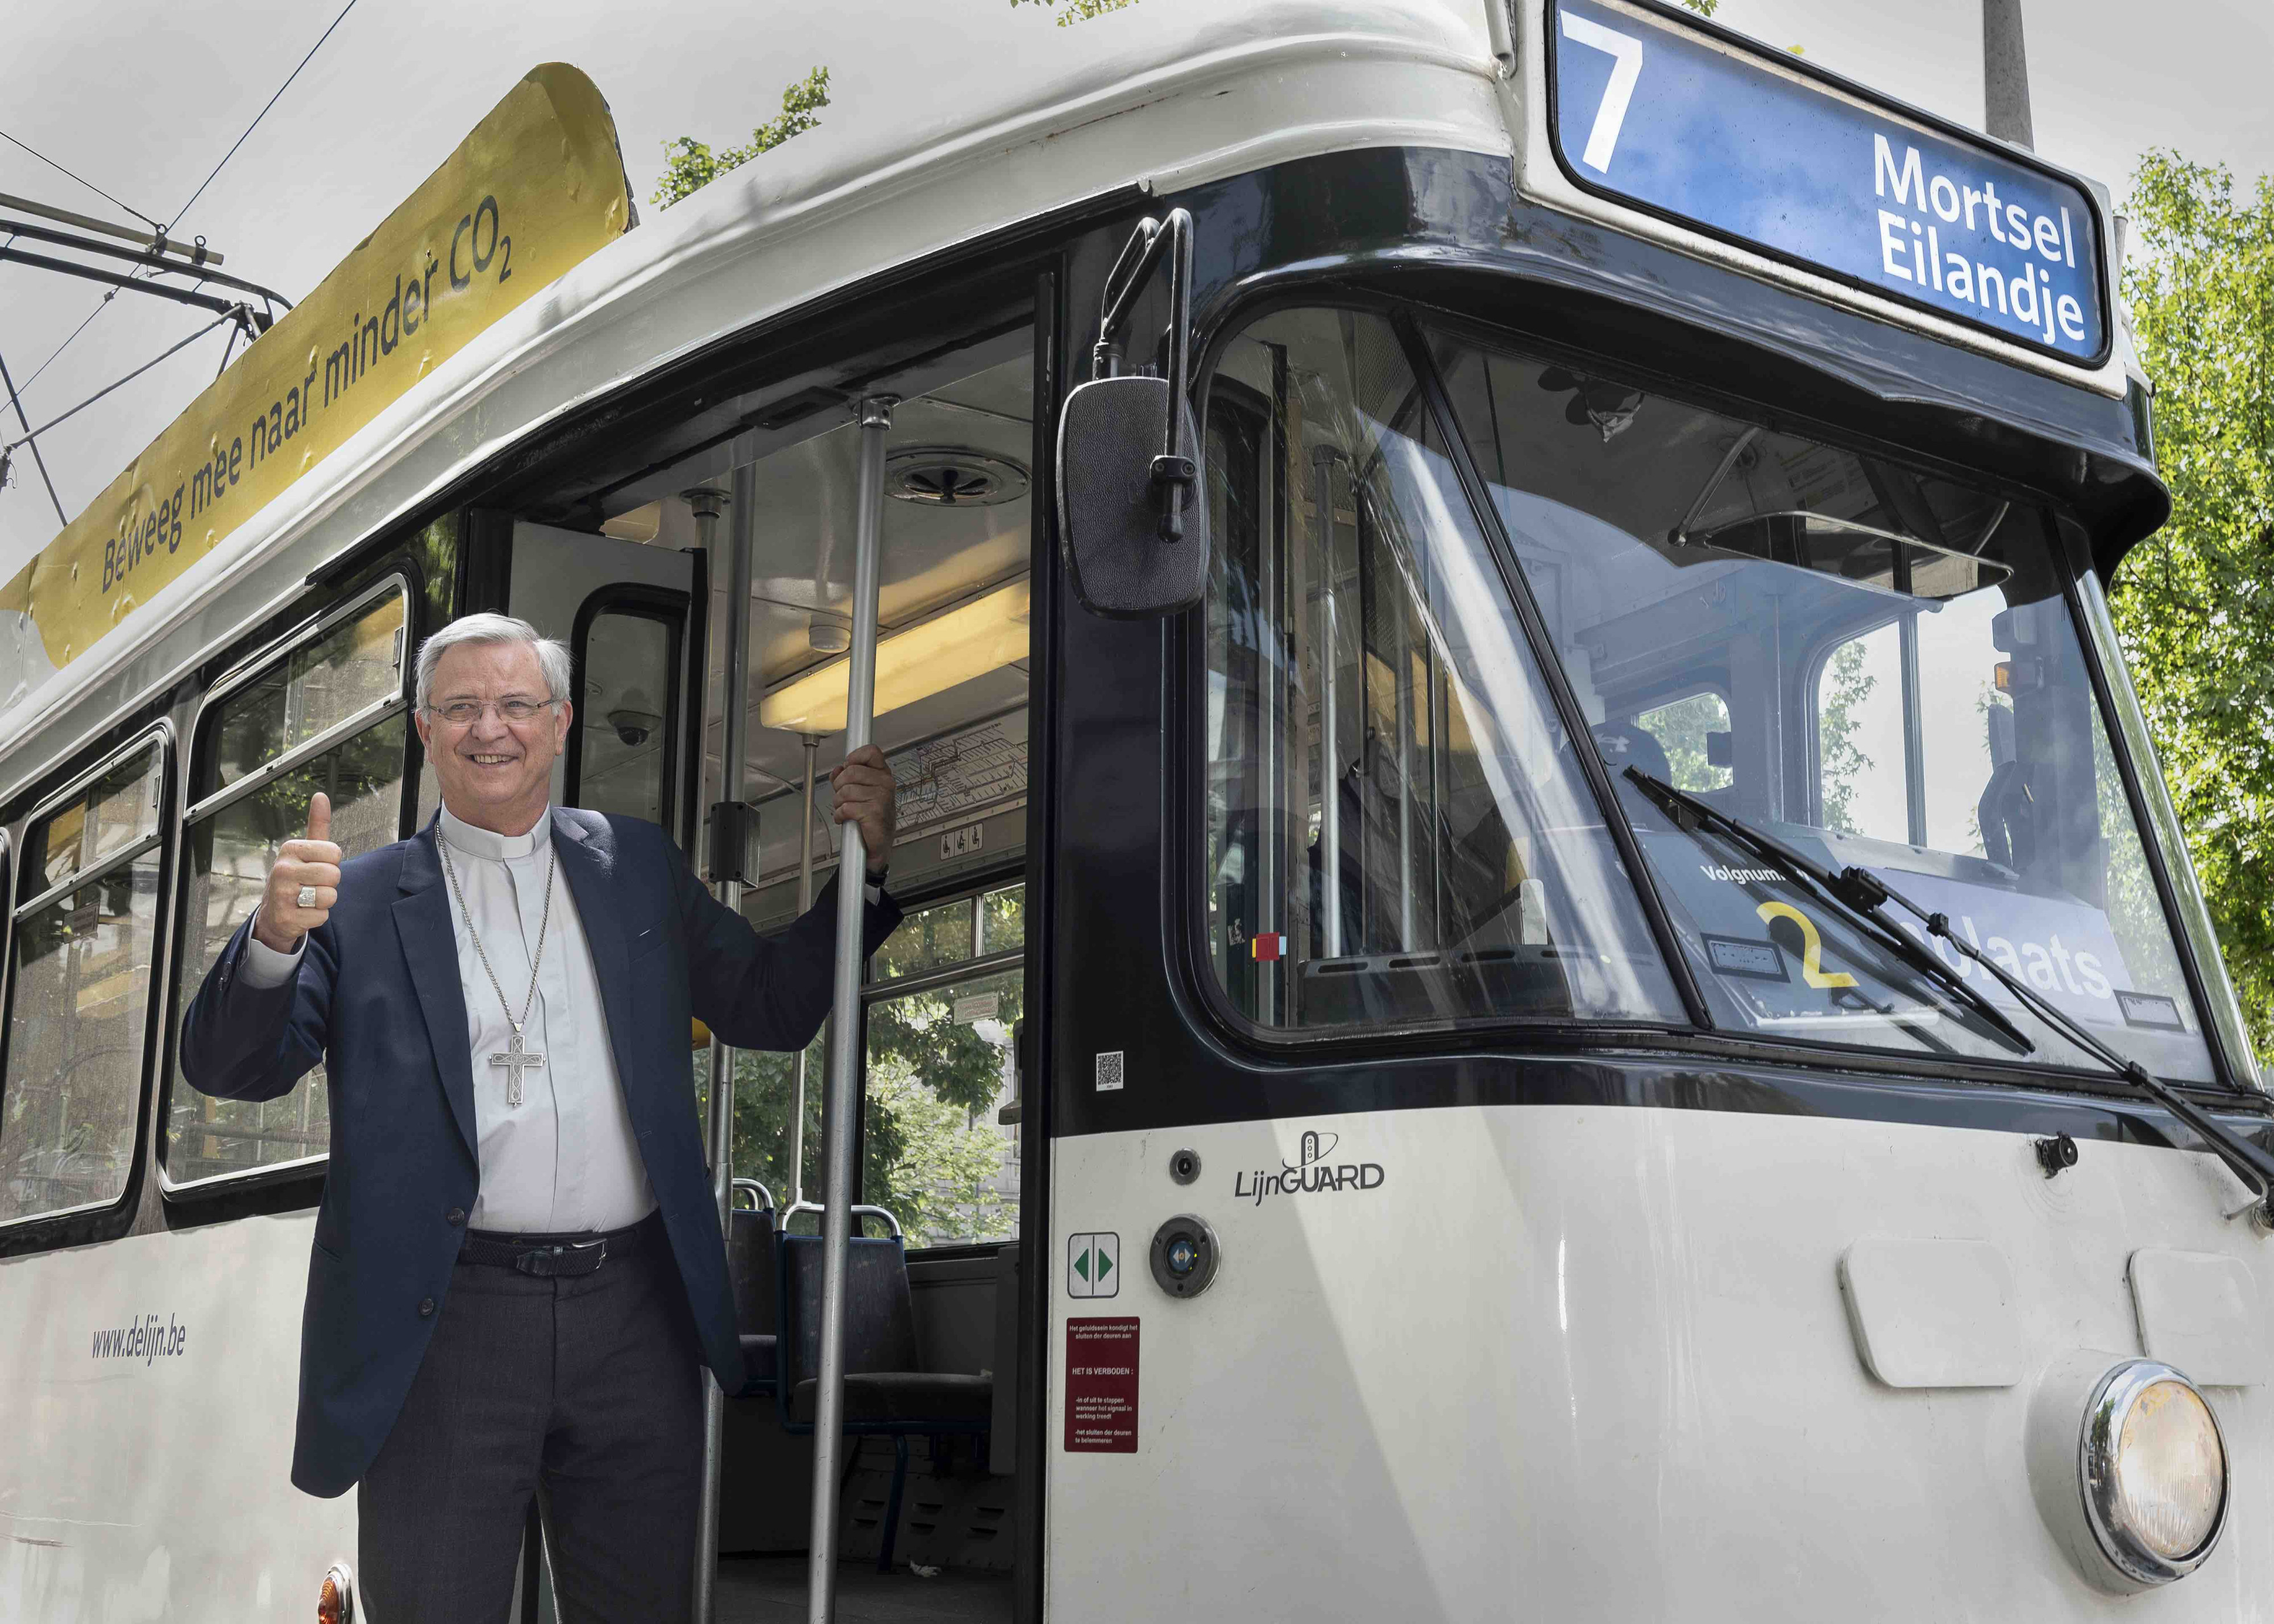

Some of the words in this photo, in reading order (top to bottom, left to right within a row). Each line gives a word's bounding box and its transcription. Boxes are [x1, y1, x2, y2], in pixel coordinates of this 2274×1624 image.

[1560, 9, 1643, 174] 7
[1874, 133, 2076, 268] Mortsel
[1878, 209, 2085, 344] Eilandje
[102, 482, 185, 595] Beweeg
[190, 436, 243, 520] mee
[250, 369, 316, 471] naar
[323, 259, 439, 409] minder
[1756, 901, 1860, 988] 2
[1234, 1160, 1385, 1207] LijnGUARD
[92, 1313, 186, 1367] www.delijn.be
